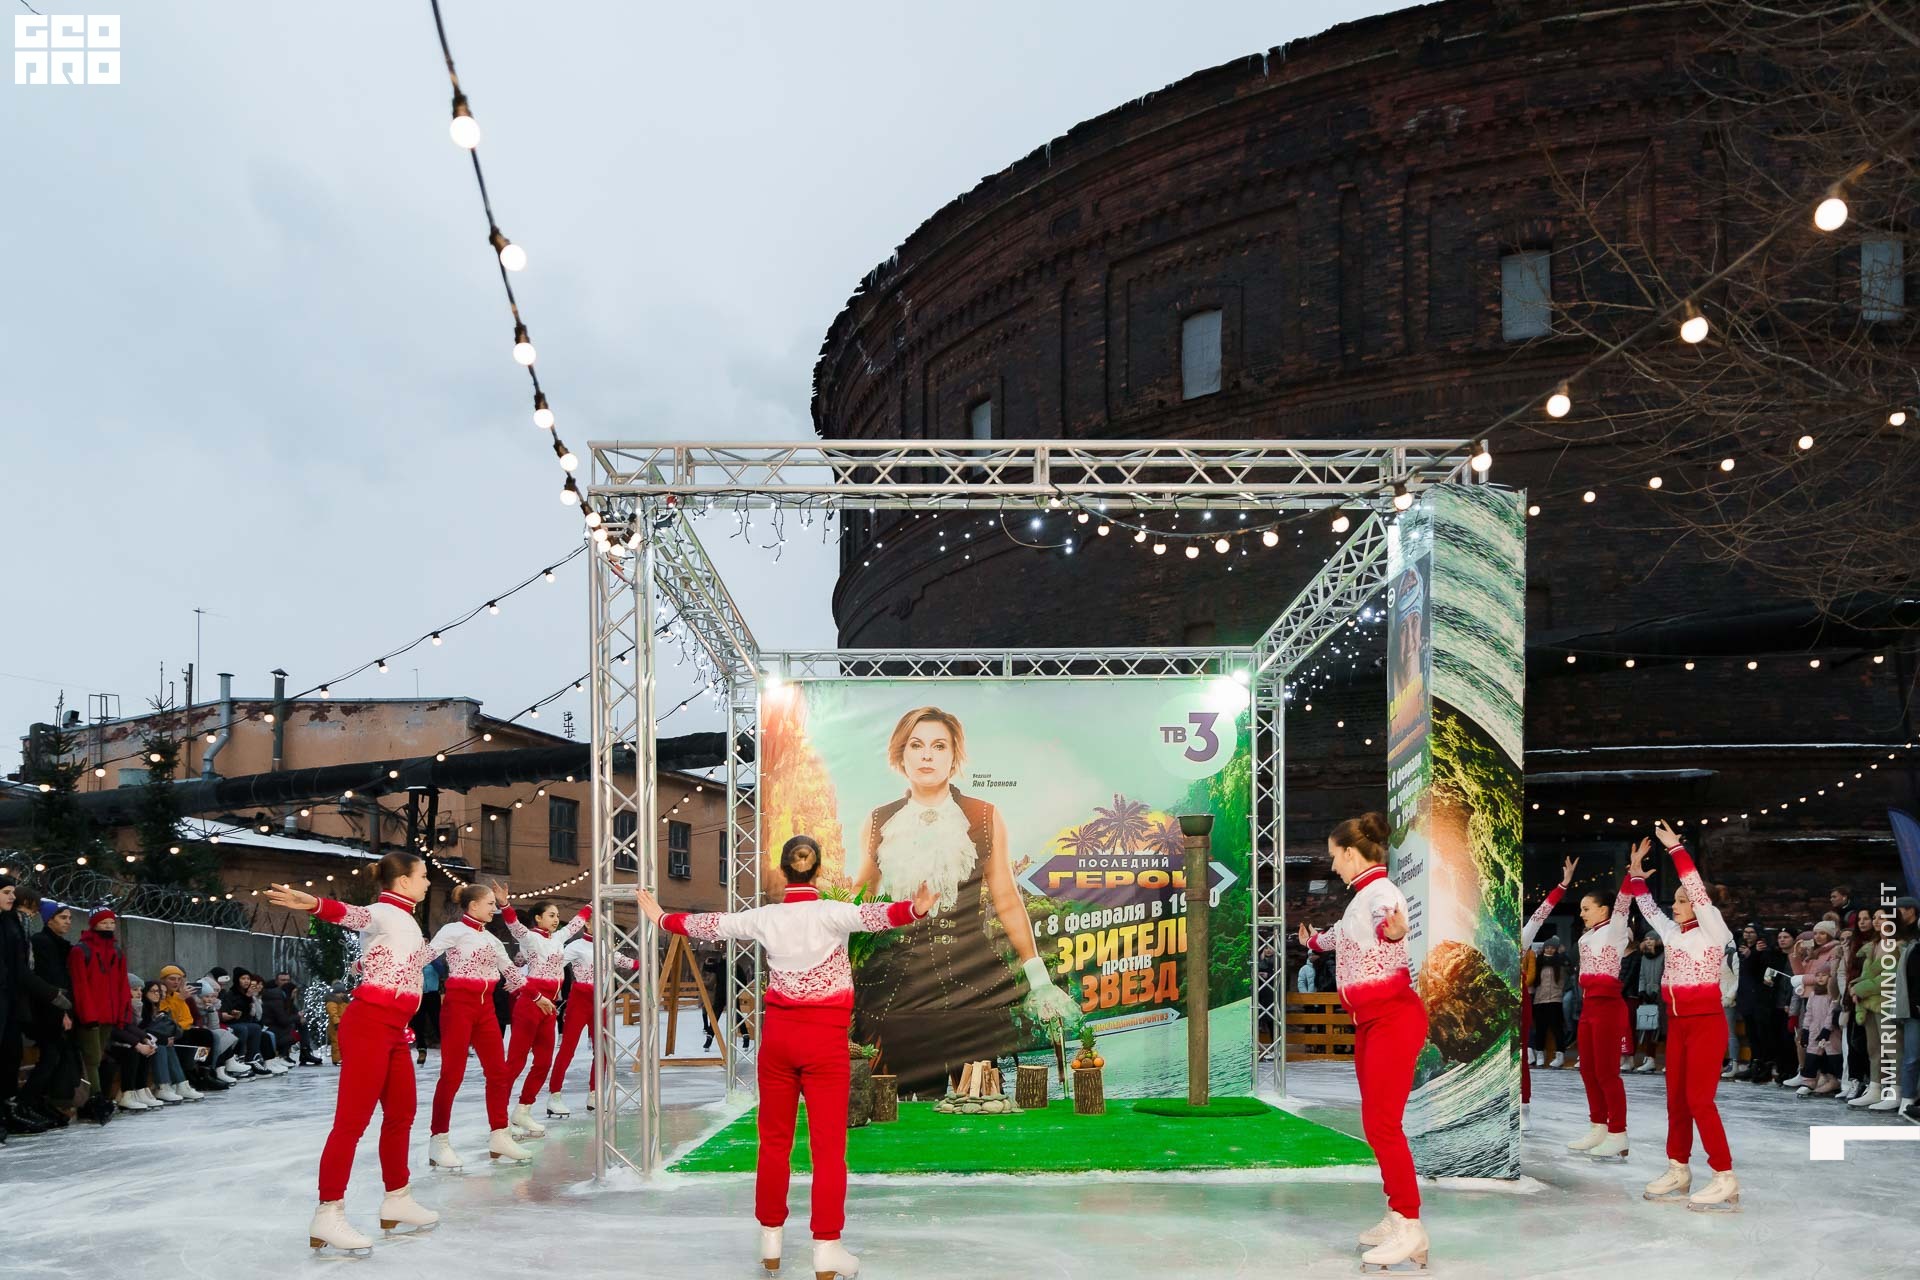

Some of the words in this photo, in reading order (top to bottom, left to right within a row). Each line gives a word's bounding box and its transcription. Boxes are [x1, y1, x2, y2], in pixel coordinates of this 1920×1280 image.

[1078, 857, 1169, 868] ПОСЛЕДНИЙ
[1046, 914, 1059, 936] 8
[1064, 903, 1145, 934] февраля
[1151, 900, 1163, 918] в
[1081, 961, 1179, 1012] ЗВЕЗД
